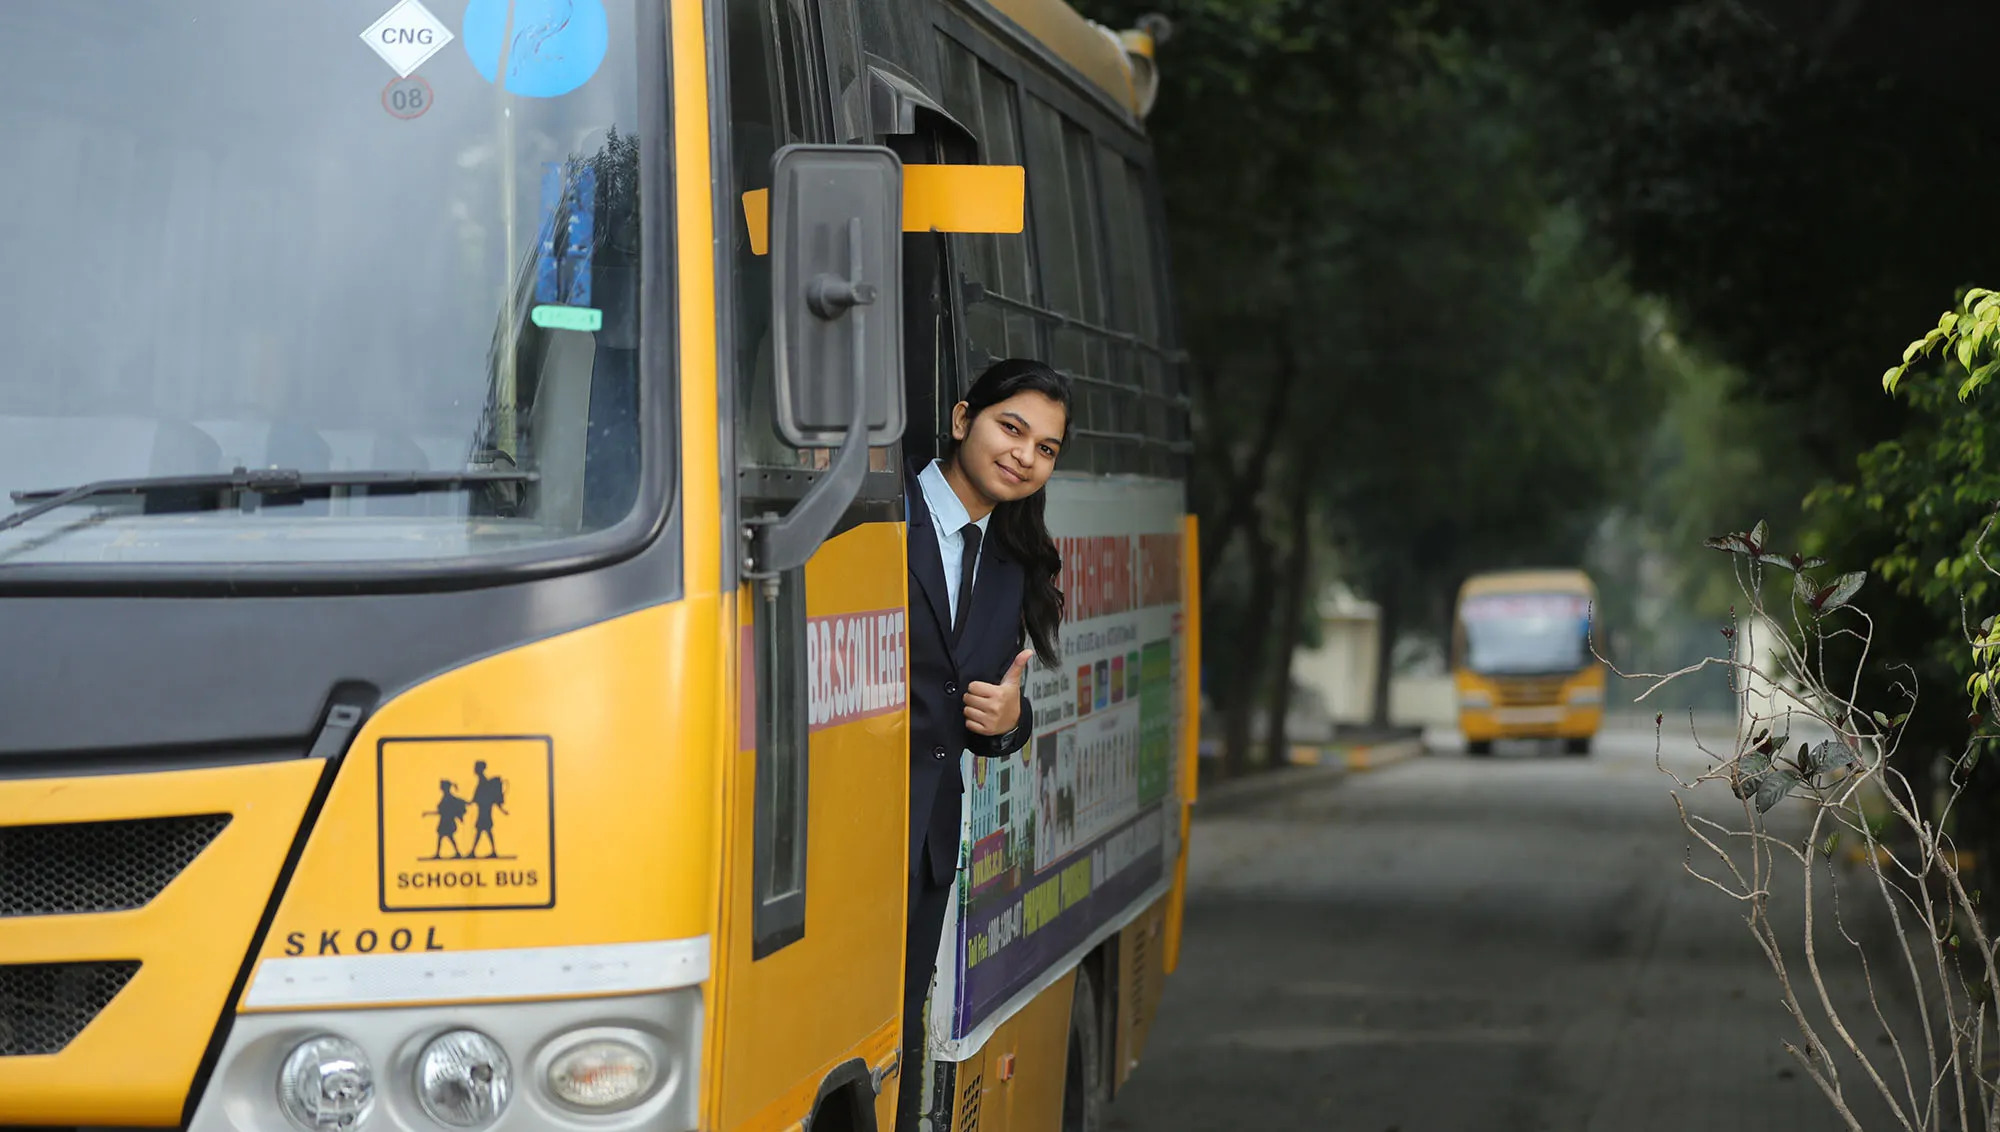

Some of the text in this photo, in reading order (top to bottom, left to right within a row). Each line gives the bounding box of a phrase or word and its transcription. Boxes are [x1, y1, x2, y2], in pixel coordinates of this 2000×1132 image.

[381, 27, 433, 45] CNG
[392, 88, 423, 111] 08
[397, 870, 538, 888] SCHOOL BUS
[284, 925, 444, 957] SKOOL
